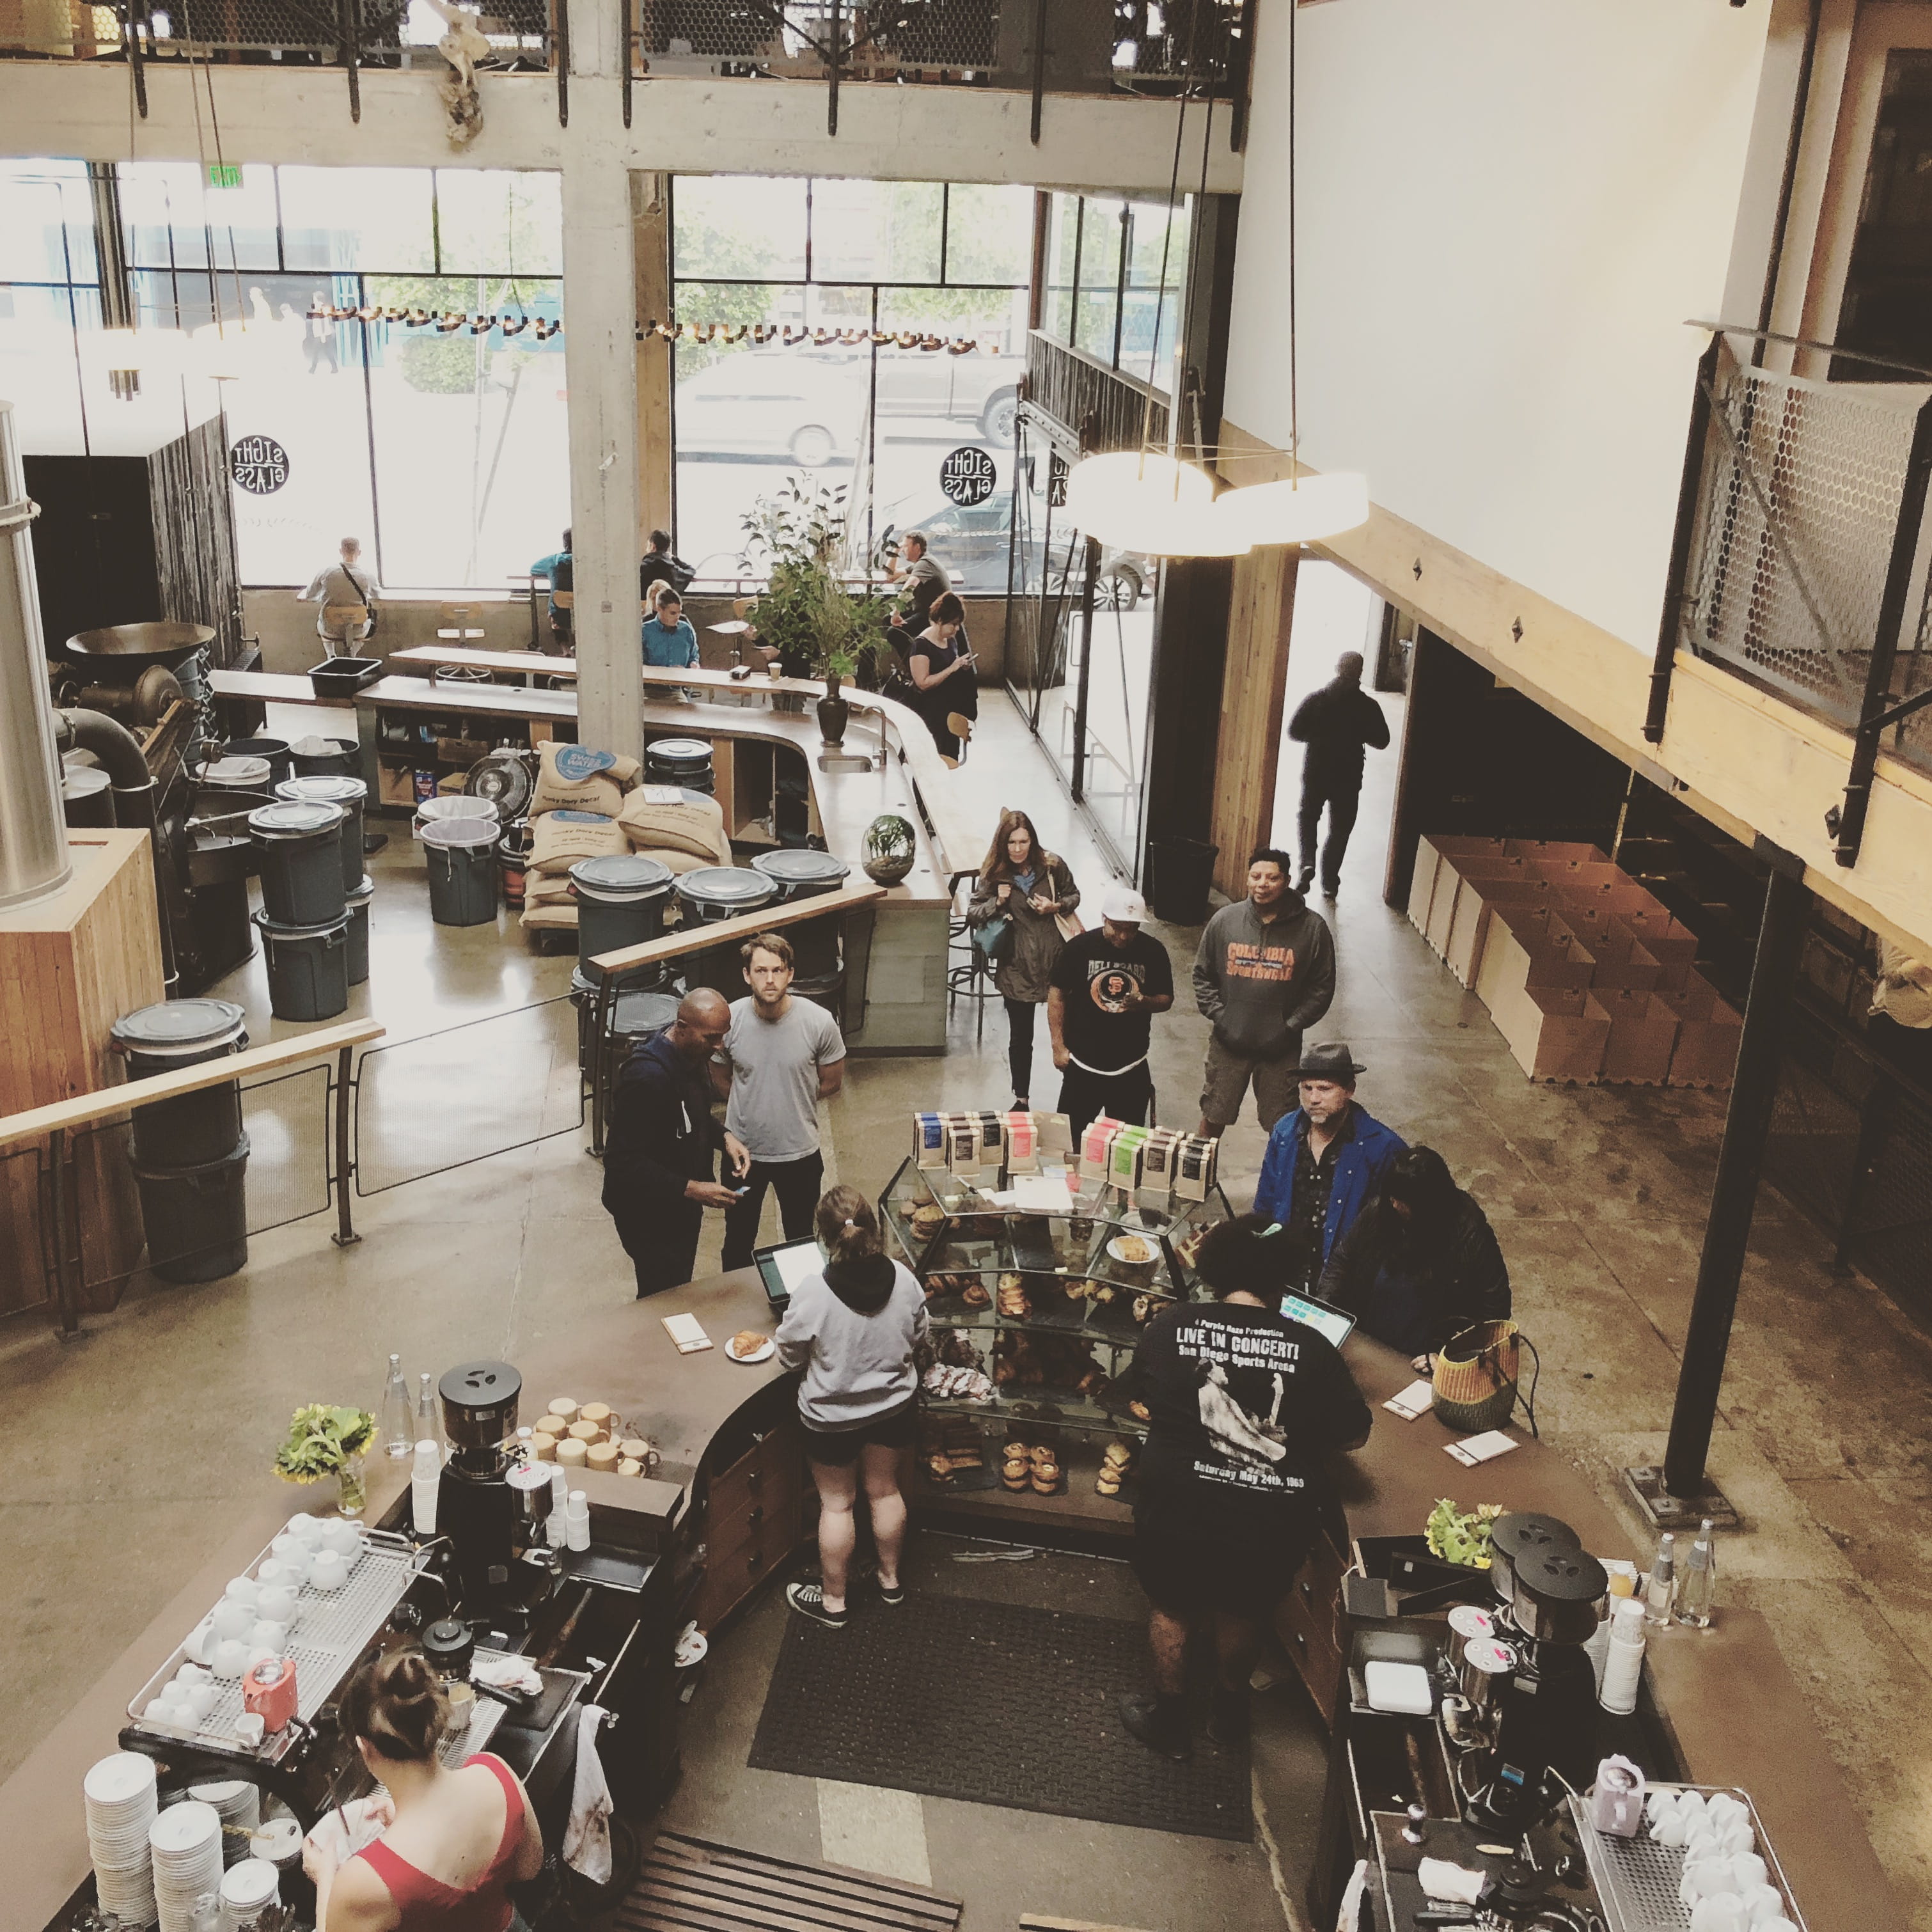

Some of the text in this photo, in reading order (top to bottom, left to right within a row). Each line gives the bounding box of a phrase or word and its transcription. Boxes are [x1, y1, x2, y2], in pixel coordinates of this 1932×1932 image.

[210, 166, 237, 187] EXIT
[1087, 960, 1111, 981] DELI
[1176, 1327, 1300, 1360] LIVE IN CONCERT!
[1179, 1344, 1197, 1356] San
[1200, 1346, 1229, 1362] Diego
[1232, 1353, 1266, 1368] Sports
[1239, 1470, 1259, 1484] May
[1261, 1474, 1284, 1487] 24th,
[1286, 1477, 1305, 1488] 1969
